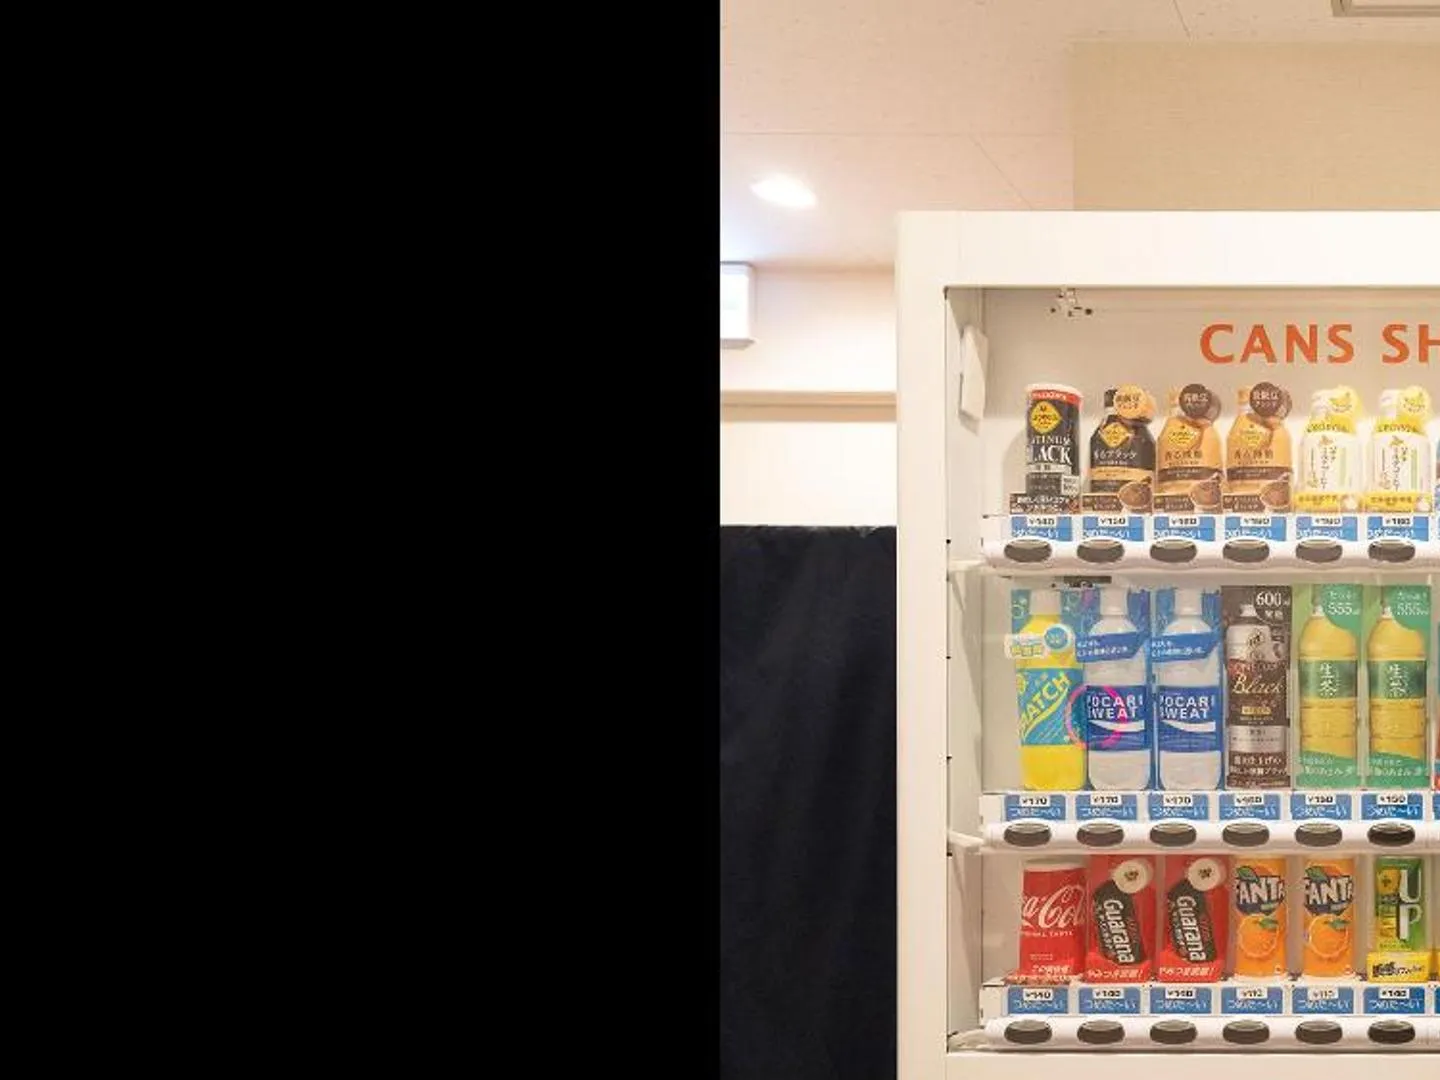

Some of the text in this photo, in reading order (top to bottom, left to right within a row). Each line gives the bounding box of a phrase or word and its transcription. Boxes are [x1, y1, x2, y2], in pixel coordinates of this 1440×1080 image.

[1200, 324, 1353, 364] CANS
[1103, 899, 1136, 963] Guarana
[1176, 896, 1207, 961] Guarana
